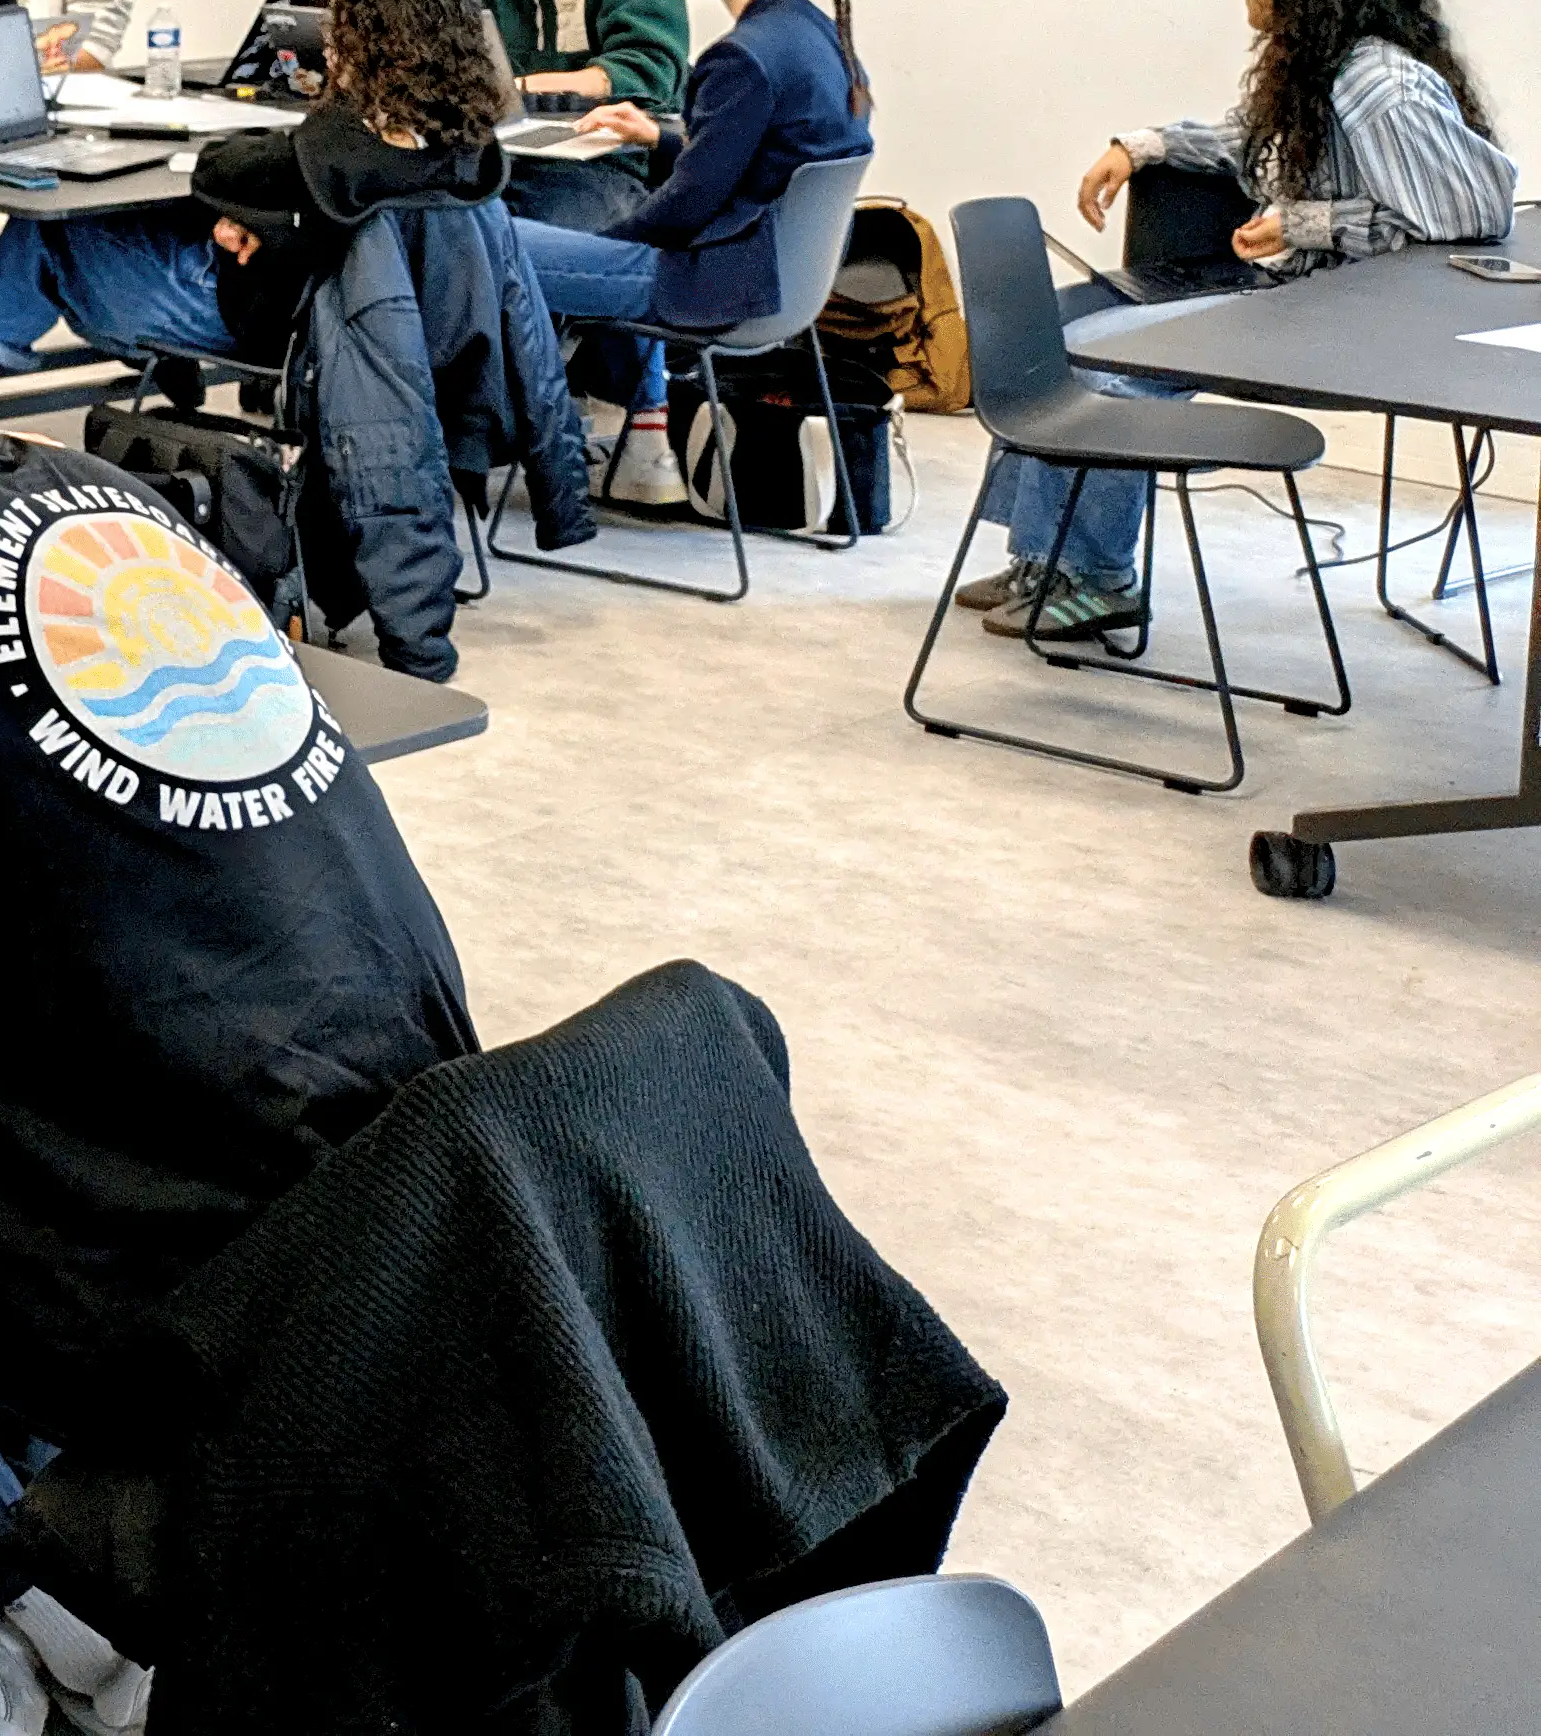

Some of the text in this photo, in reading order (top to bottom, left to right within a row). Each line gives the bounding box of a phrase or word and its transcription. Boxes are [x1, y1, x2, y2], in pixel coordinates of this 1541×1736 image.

[28, 708, 346, 832] WIND WATER FIRE
